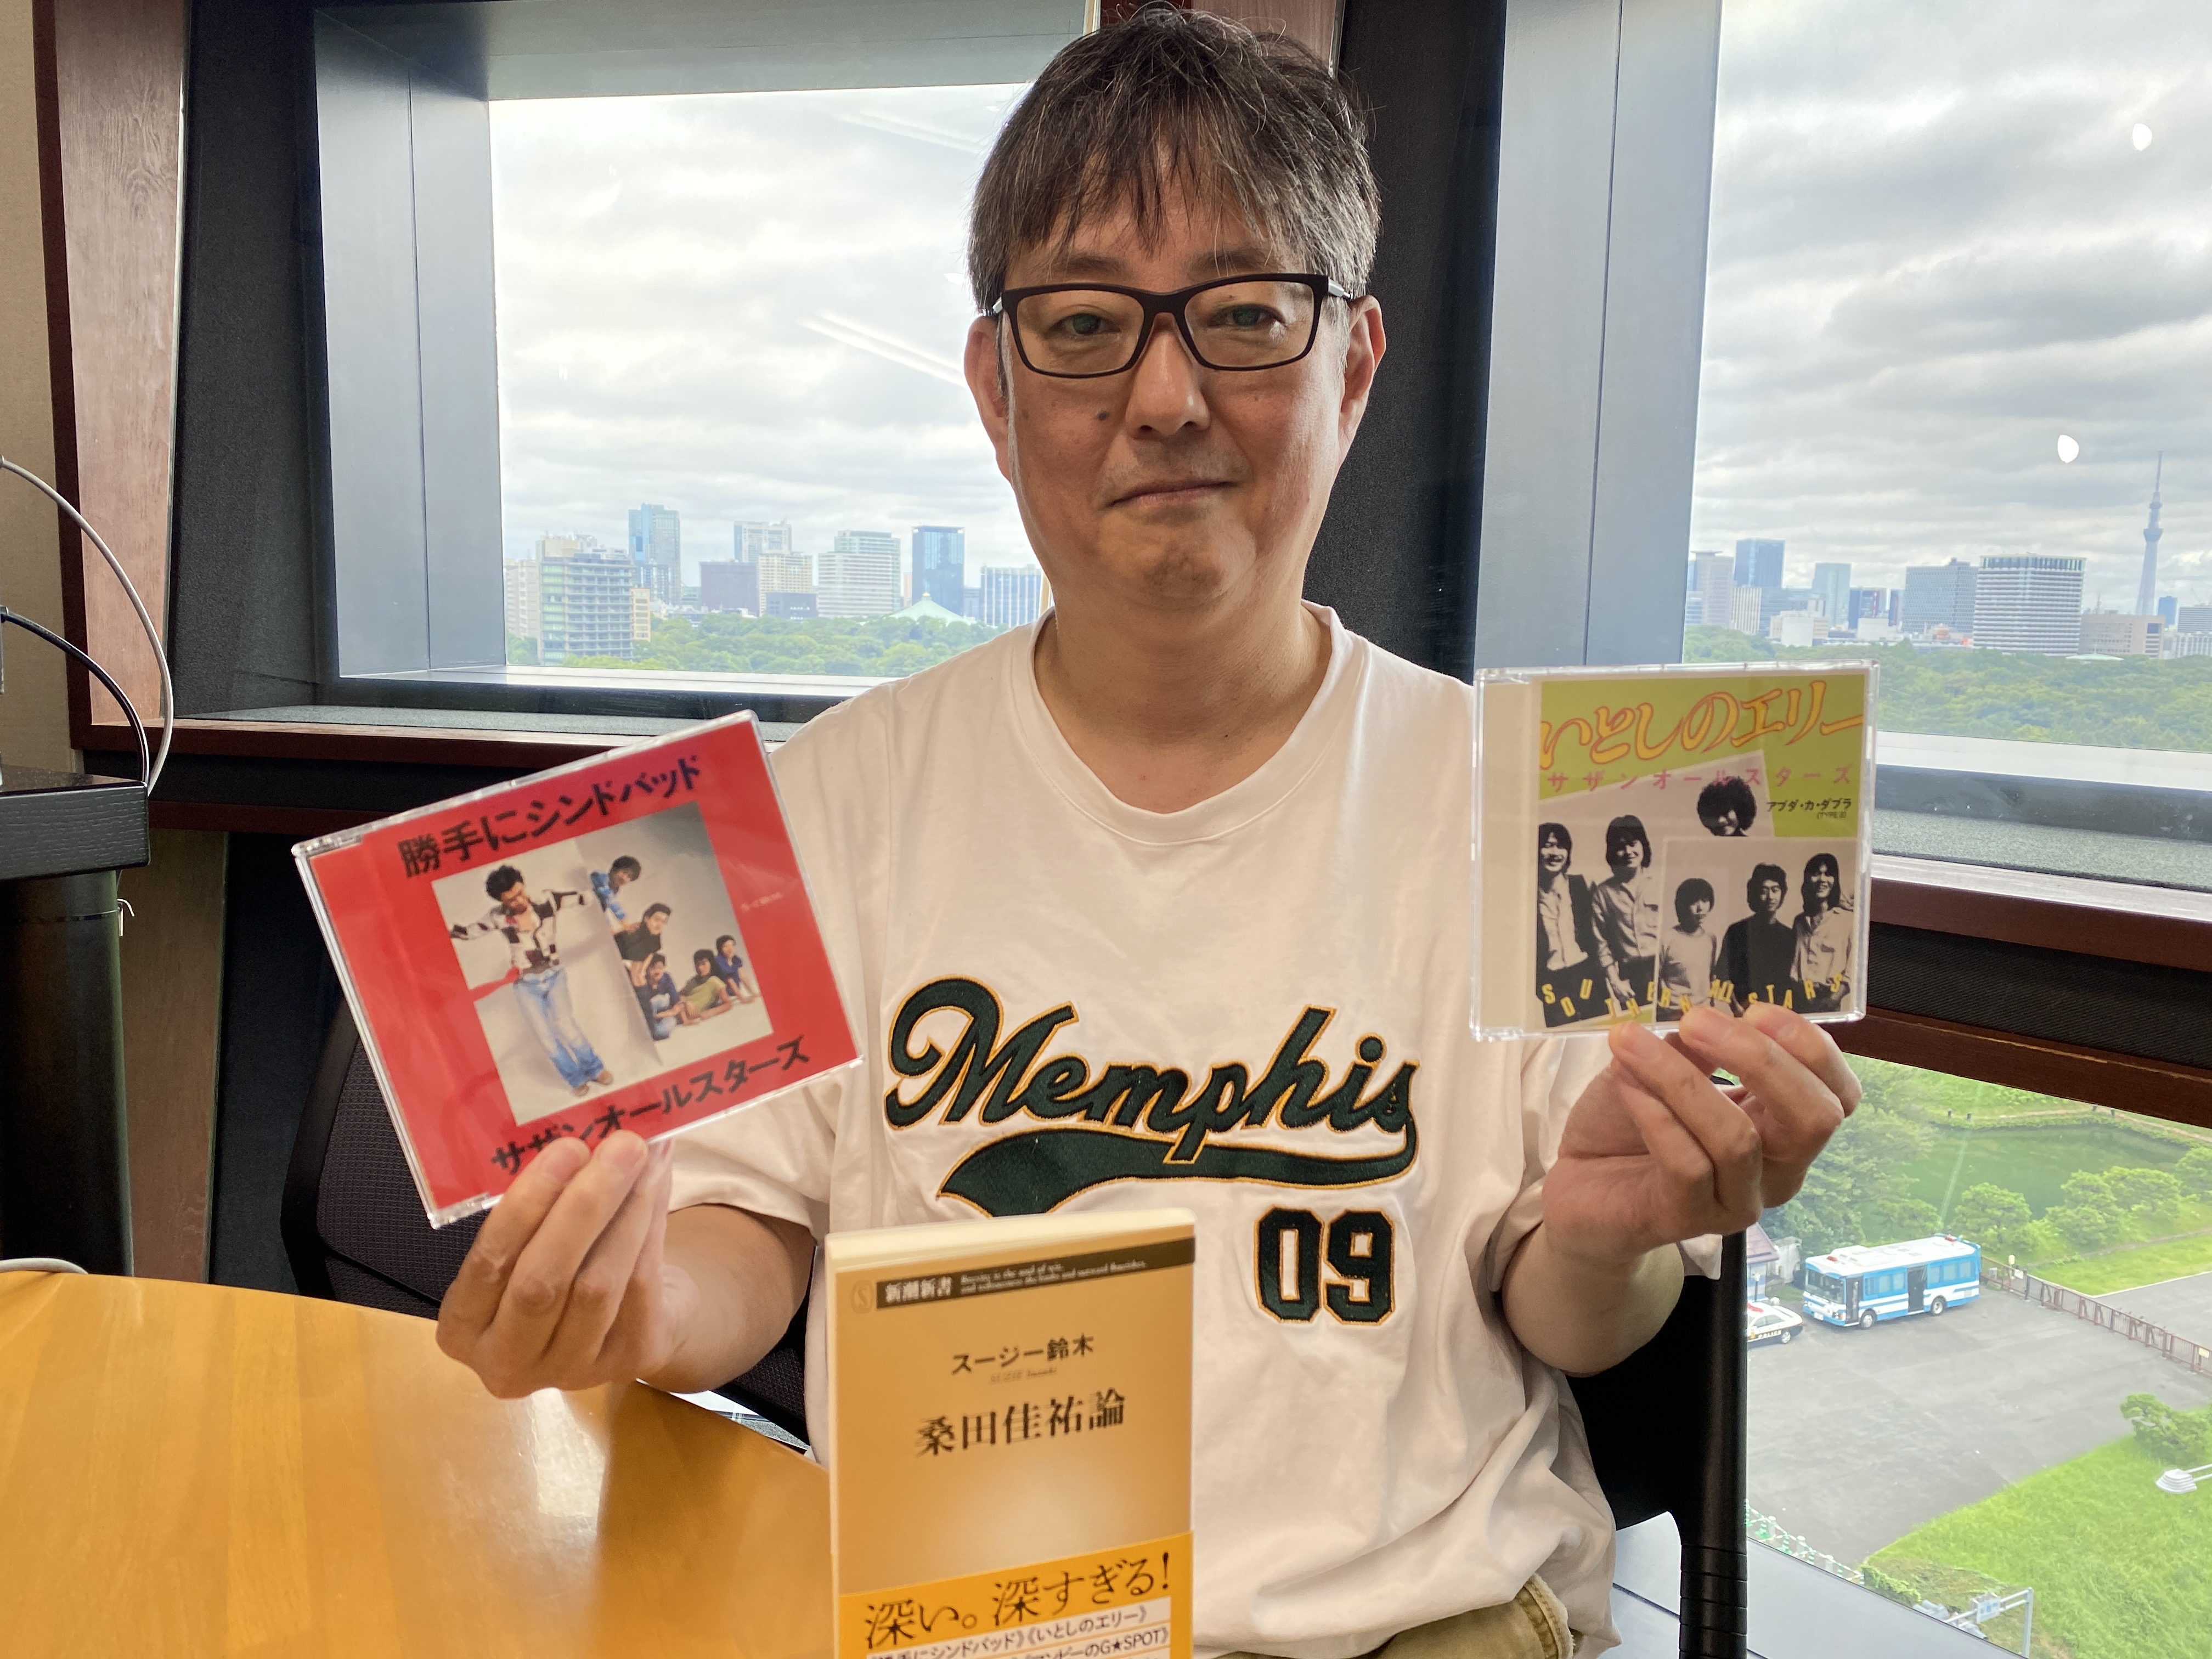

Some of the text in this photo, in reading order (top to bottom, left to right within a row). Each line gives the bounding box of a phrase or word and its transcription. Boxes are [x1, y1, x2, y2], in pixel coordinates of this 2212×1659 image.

[1539, 680, 1863, 770] いとしのエリー
[397, 755, 701, 878] 勝手にシンドバッド
[1547, 764, 1852, 792] サザンオールスターズ
[883, 974, 1421, 1164] Memphis
[1254, 1204, 1396, 1325] 09
[951, 1333, 1094, 1375] スージー鈴木
[915, 1387, 1125, 1456] 桑田佳祐論
